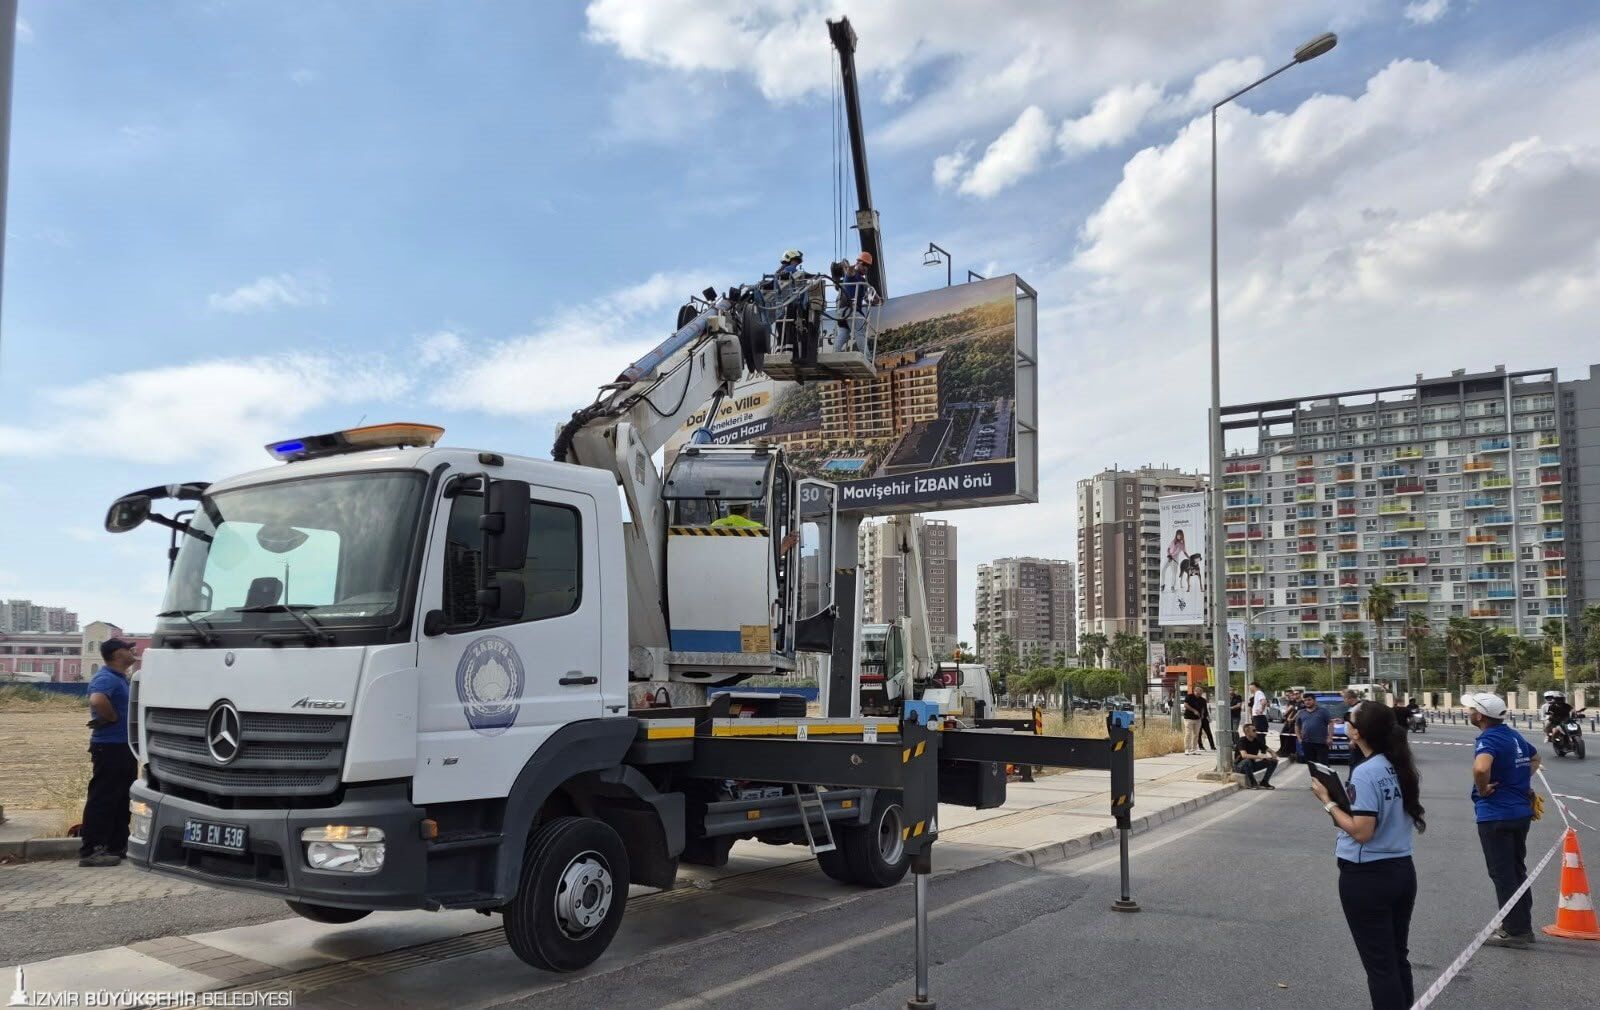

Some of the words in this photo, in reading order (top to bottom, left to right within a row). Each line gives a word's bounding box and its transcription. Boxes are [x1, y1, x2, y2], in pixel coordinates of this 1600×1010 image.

[720, 406, 733, 416] ve
[735, 396, 761, 411] Villa
[740, 422, 767, 437] Hazır
[843, 482, 912, 500] Mavişehir
[914, 476, 959, 493] İZBAN
[962, 472, 992, 489] önü
[473, 640, 511, 658] ZABITA
[190, 822, 202, 842] 35
[207, 825, 221, 844] EN
[224, 827, 244, 848] 538
